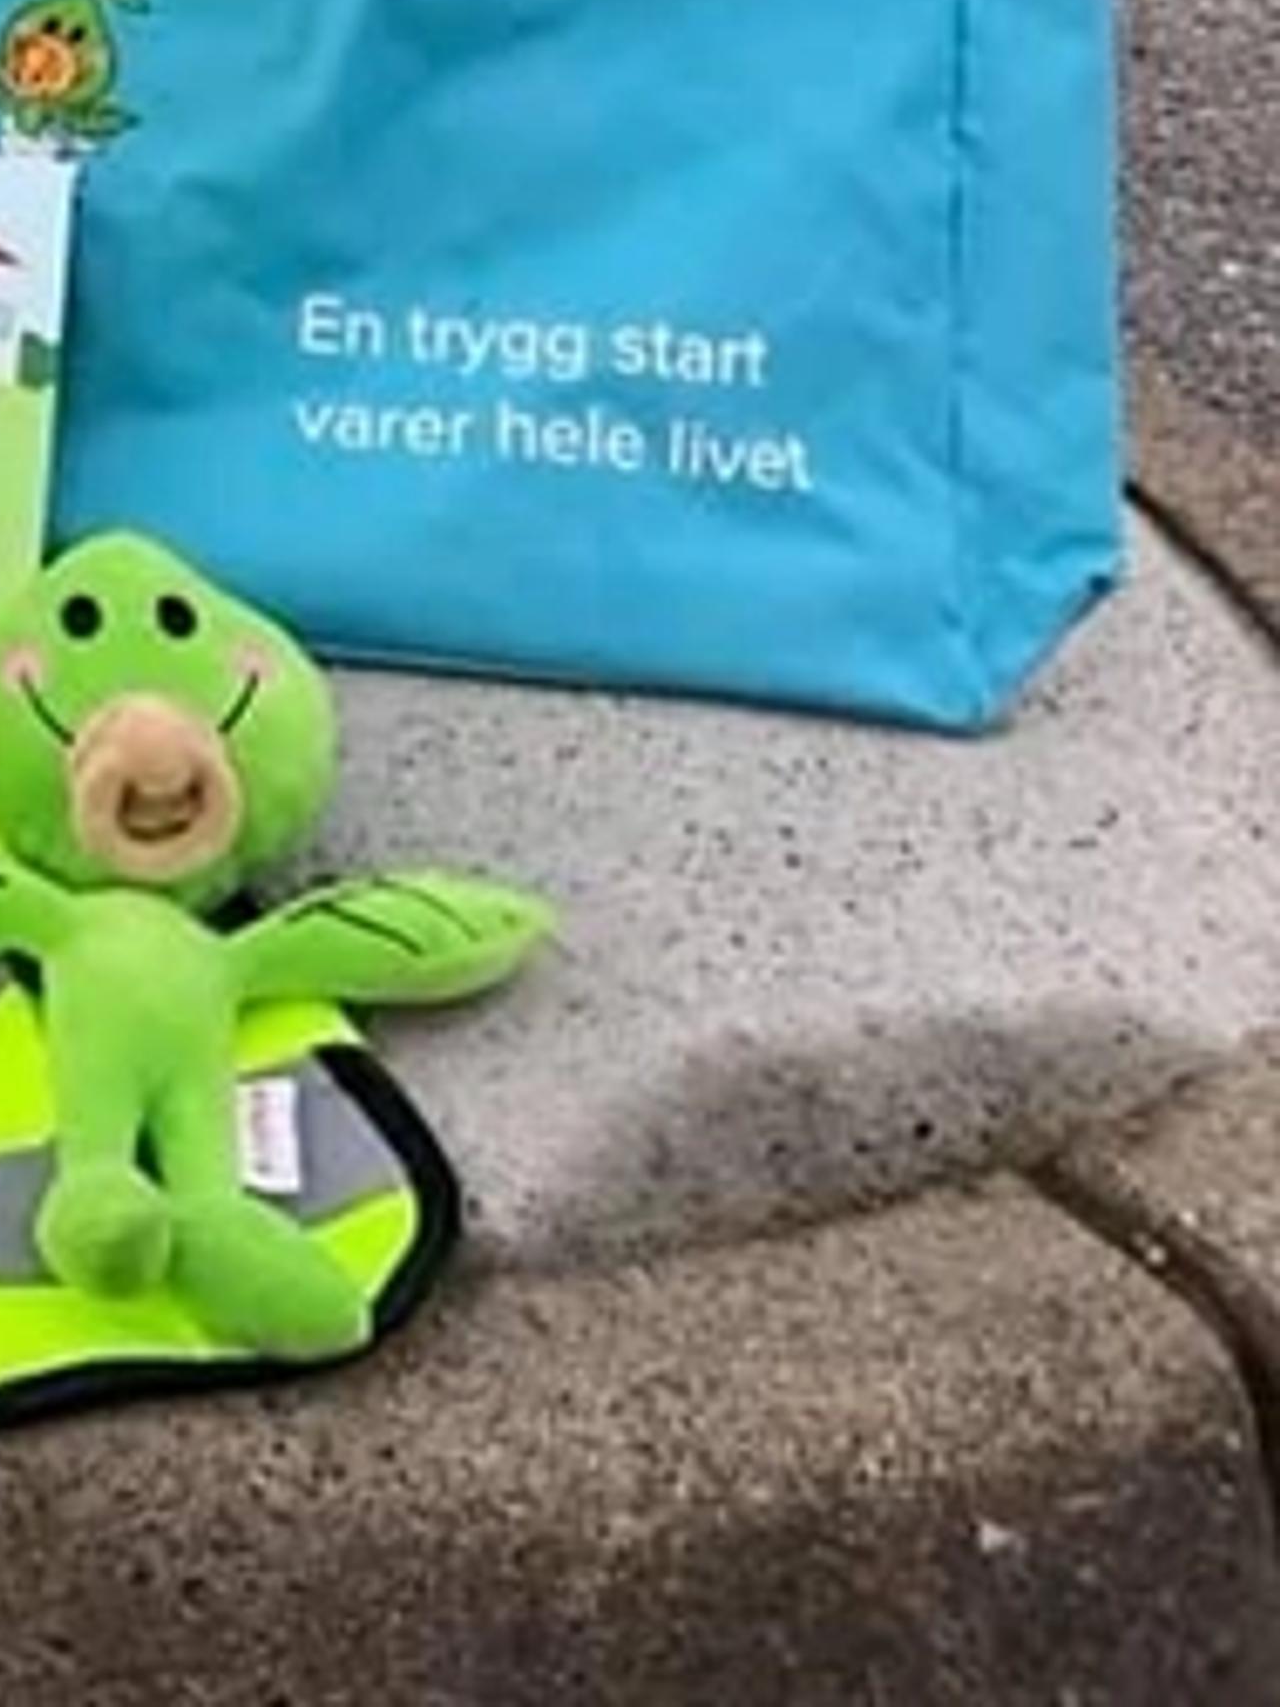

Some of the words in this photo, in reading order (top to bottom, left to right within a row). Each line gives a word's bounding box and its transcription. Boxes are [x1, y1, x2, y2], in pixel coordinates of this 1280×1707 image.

[296, 293, 383, 359] En
[407, 304, 589, 383] trygg
[611, 322, 771, 389] start
[293, 397, 472, 459] varer
[495, 399, 646, 474] hele
[666, 416, 816, 494] livet
